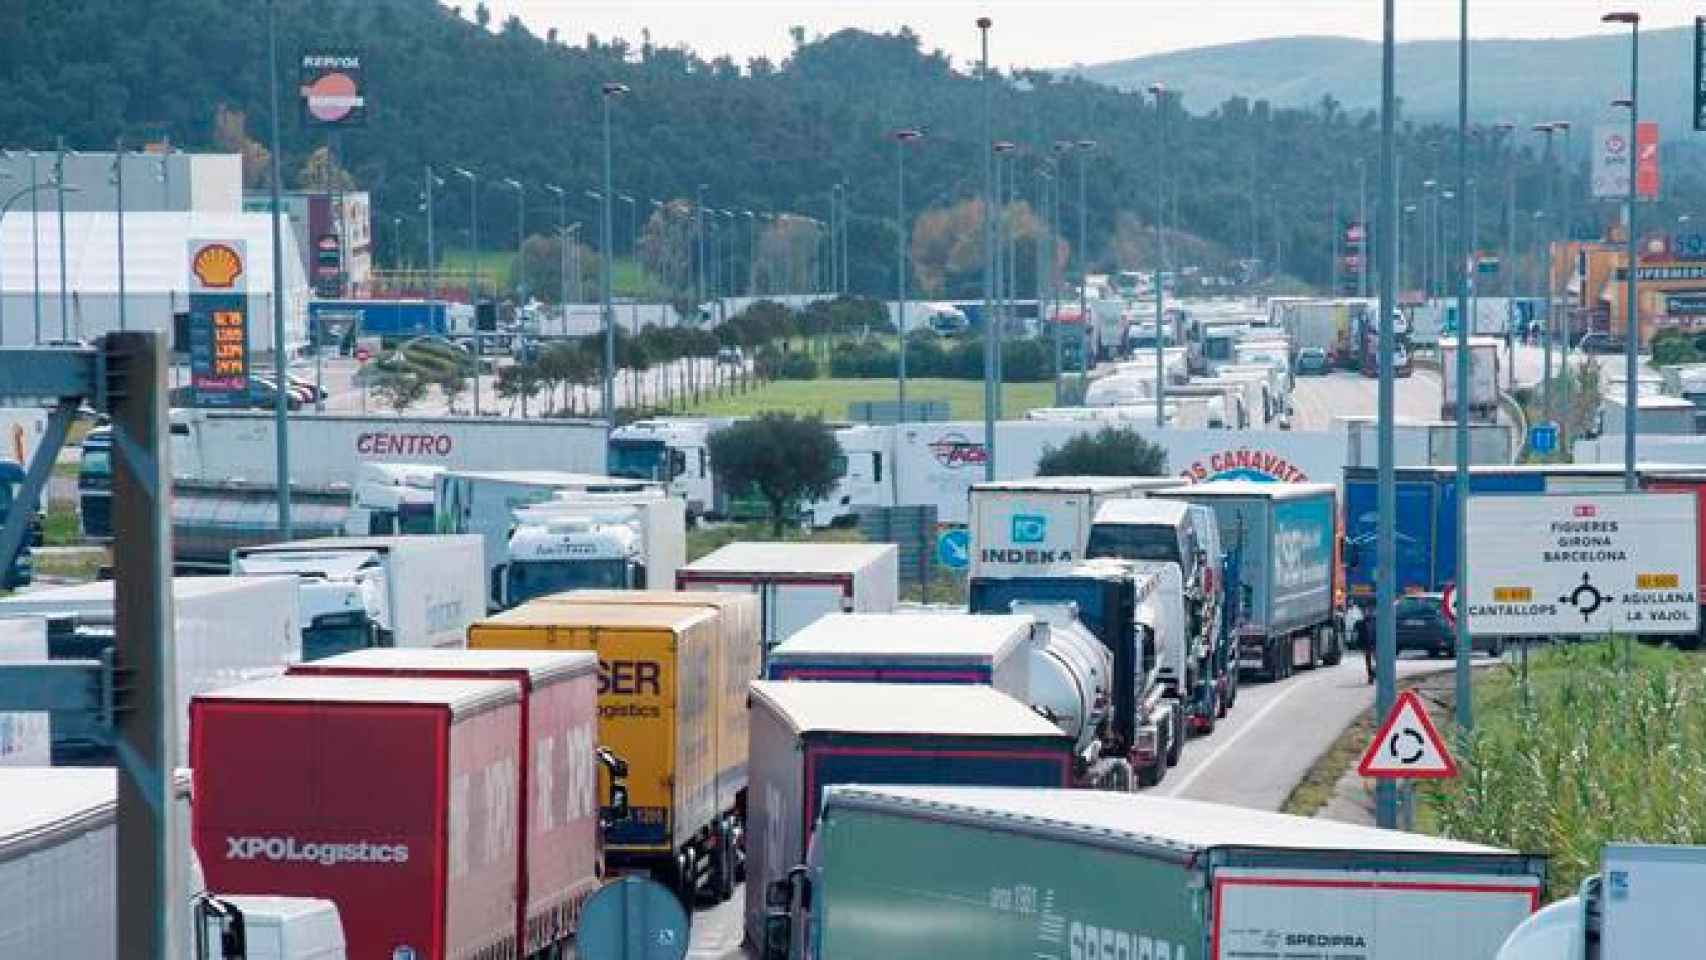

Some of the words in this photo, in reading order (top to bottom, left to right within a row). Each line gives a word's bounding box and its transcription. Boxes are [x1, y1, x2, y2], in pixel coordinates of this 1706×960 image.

[357, 432, 452, 456] CENTRO
[1551, 521, 1618, 532] FIGUERES
[1558, 536, 1611, 547] GIRONA
[982, 549, 1072, 563] INDEKA
[1543, 551, 1626, 562] BARCELONA
[1622, 593, 1695, 604] AGULLANA
[1468, 604, 1557, 616] CANTALLOPS
[1627, 610, 1643, 621] LA
[1650, 609, 1691, 622] VAJOL
[226, 836, 409, 865] XPOLogistics
[1285, 934, 1367, 948] SPEDIPRA
